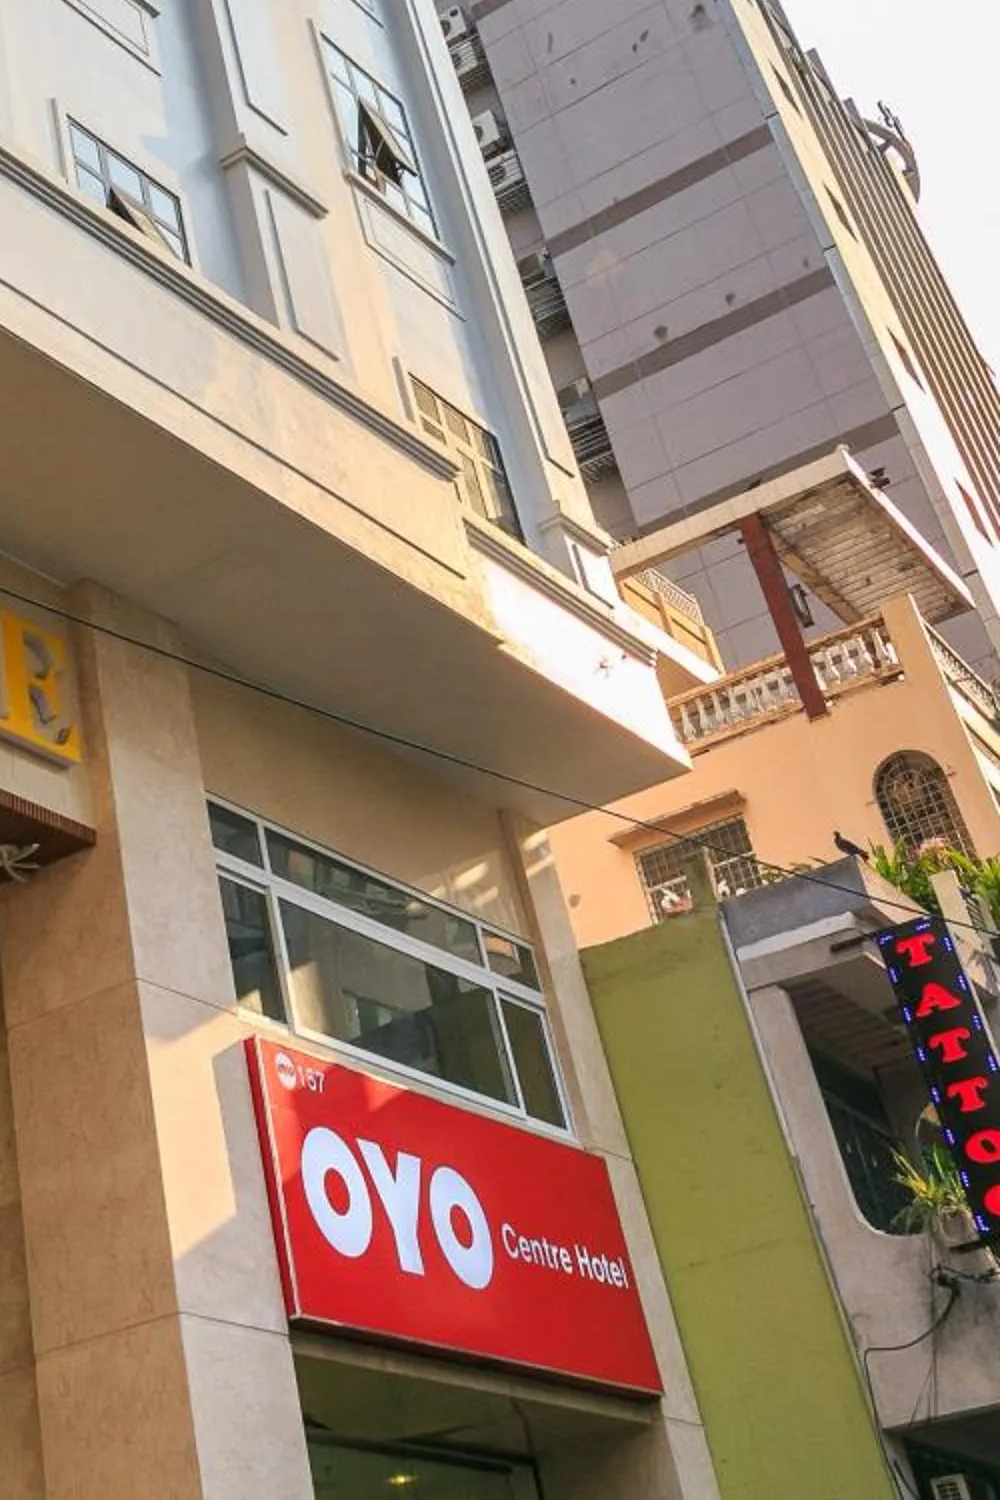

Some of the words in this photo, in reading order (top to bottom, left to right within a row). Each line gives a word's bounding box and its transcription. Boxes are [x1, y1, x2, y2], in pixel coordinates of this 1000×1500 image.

[302, 1126, 494, 1289] OYO
[502, 1222, 573, 1275] Centre
[574, 1244, 629, 1289] Hotel
